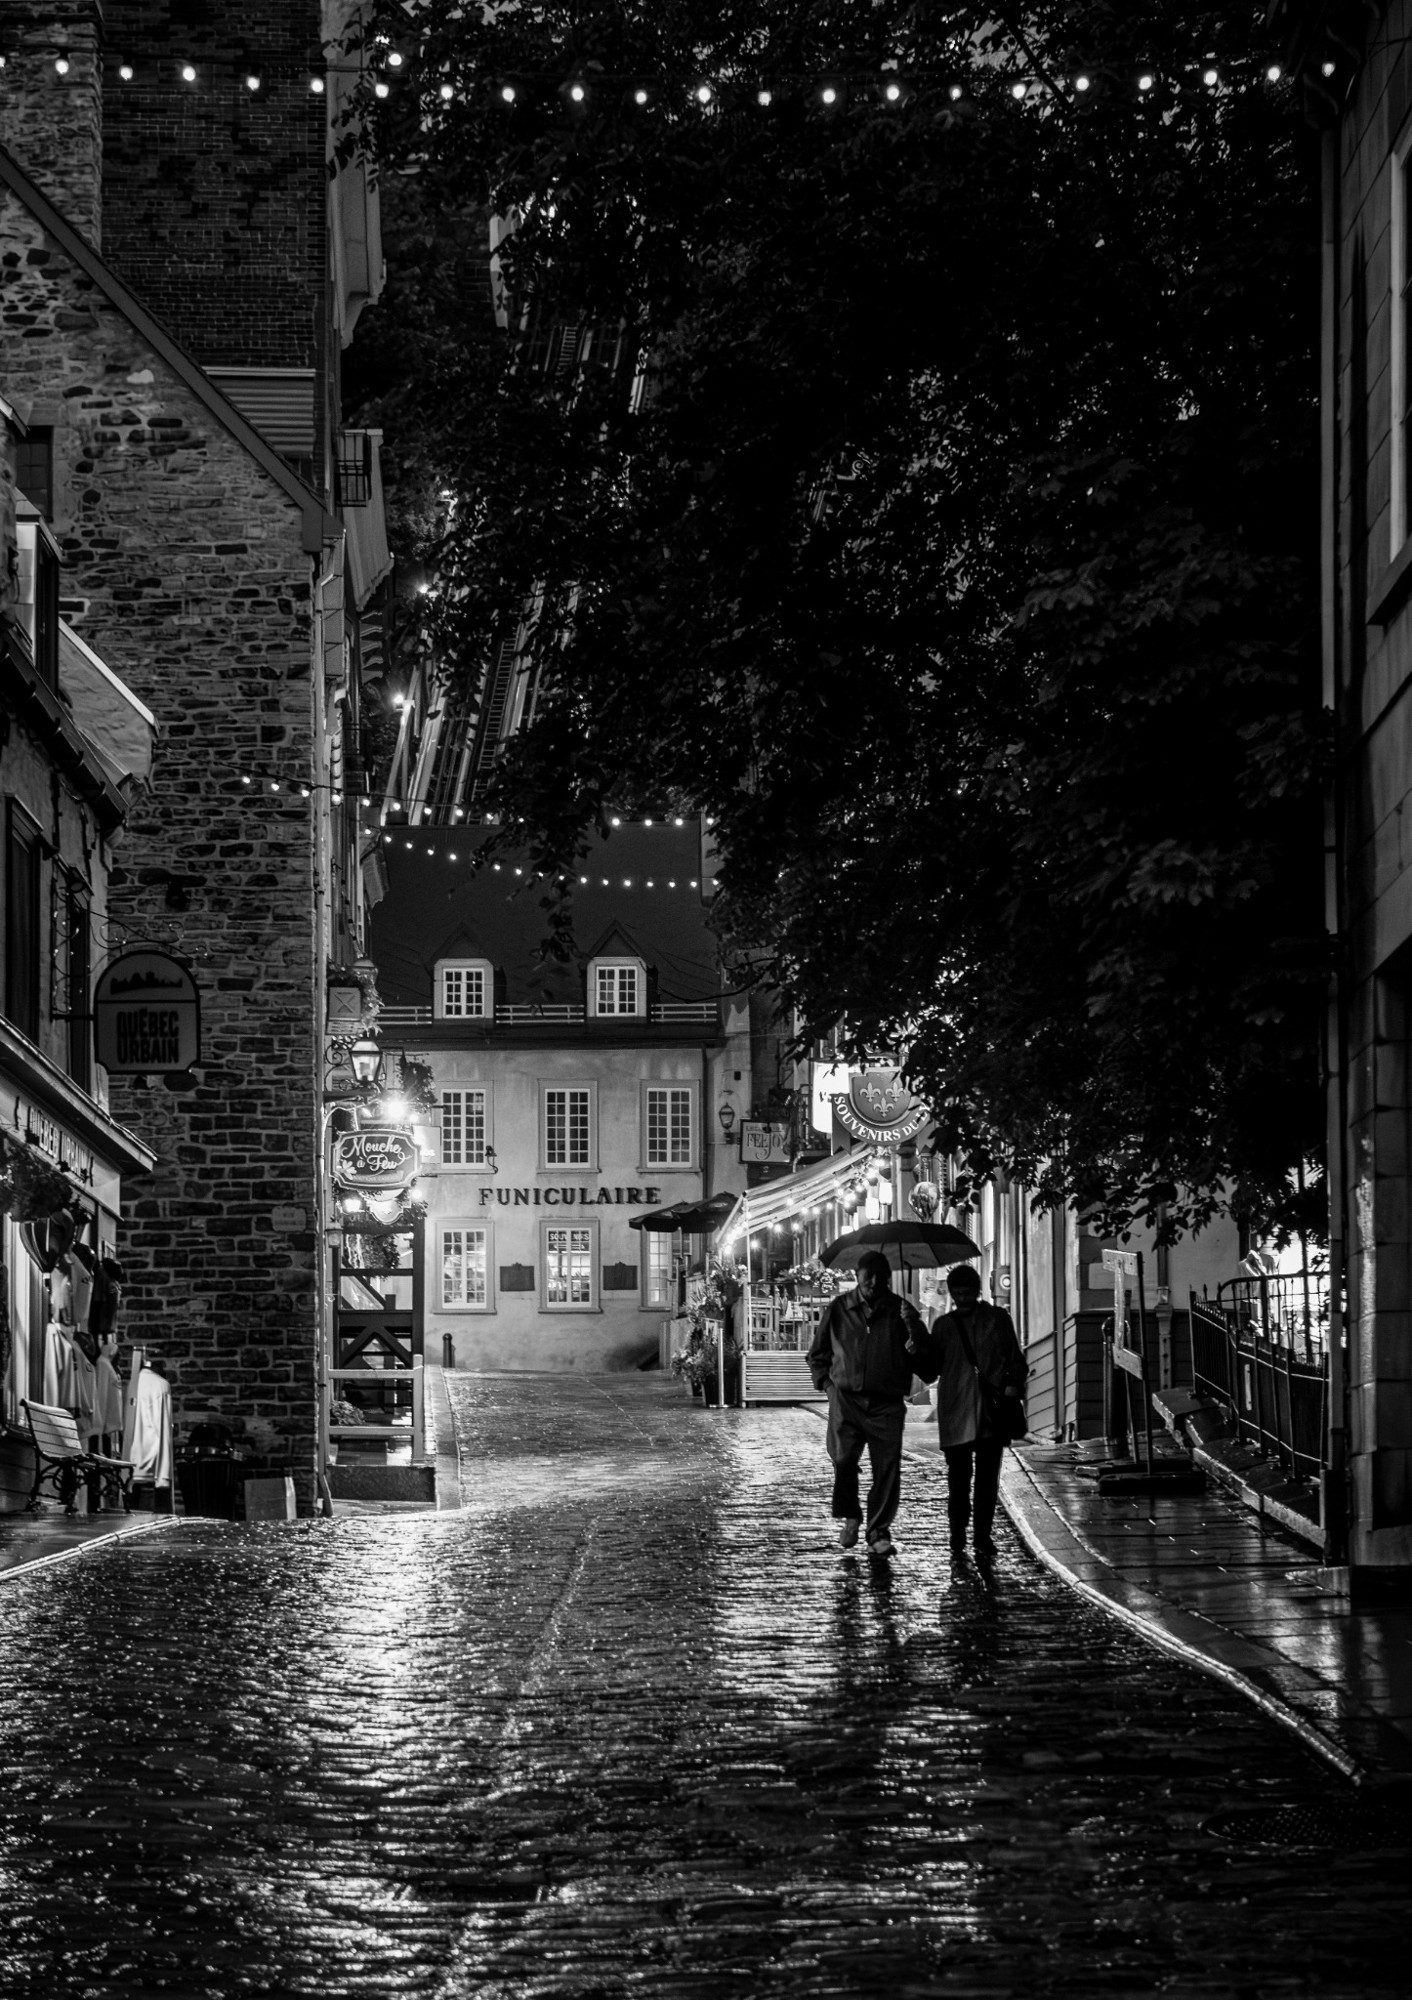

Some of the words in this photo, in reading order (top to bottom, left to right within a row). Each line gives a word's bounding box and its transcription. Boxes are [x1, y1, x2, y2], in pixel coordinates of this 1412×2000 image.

[118, 1009, 179, 1037] QUÉBEC
[118, 1039, 179, 1063] URBAIN
[834, 1096, 901, 1142] SOUVENIRS
[901, 1119, 919, 1136] DU
[341, 1135, 404, 1158] Mouche
[366, 1153, 399, 1171] Feu
[479, 1187, 661, 1205] FUNICULAIRE
